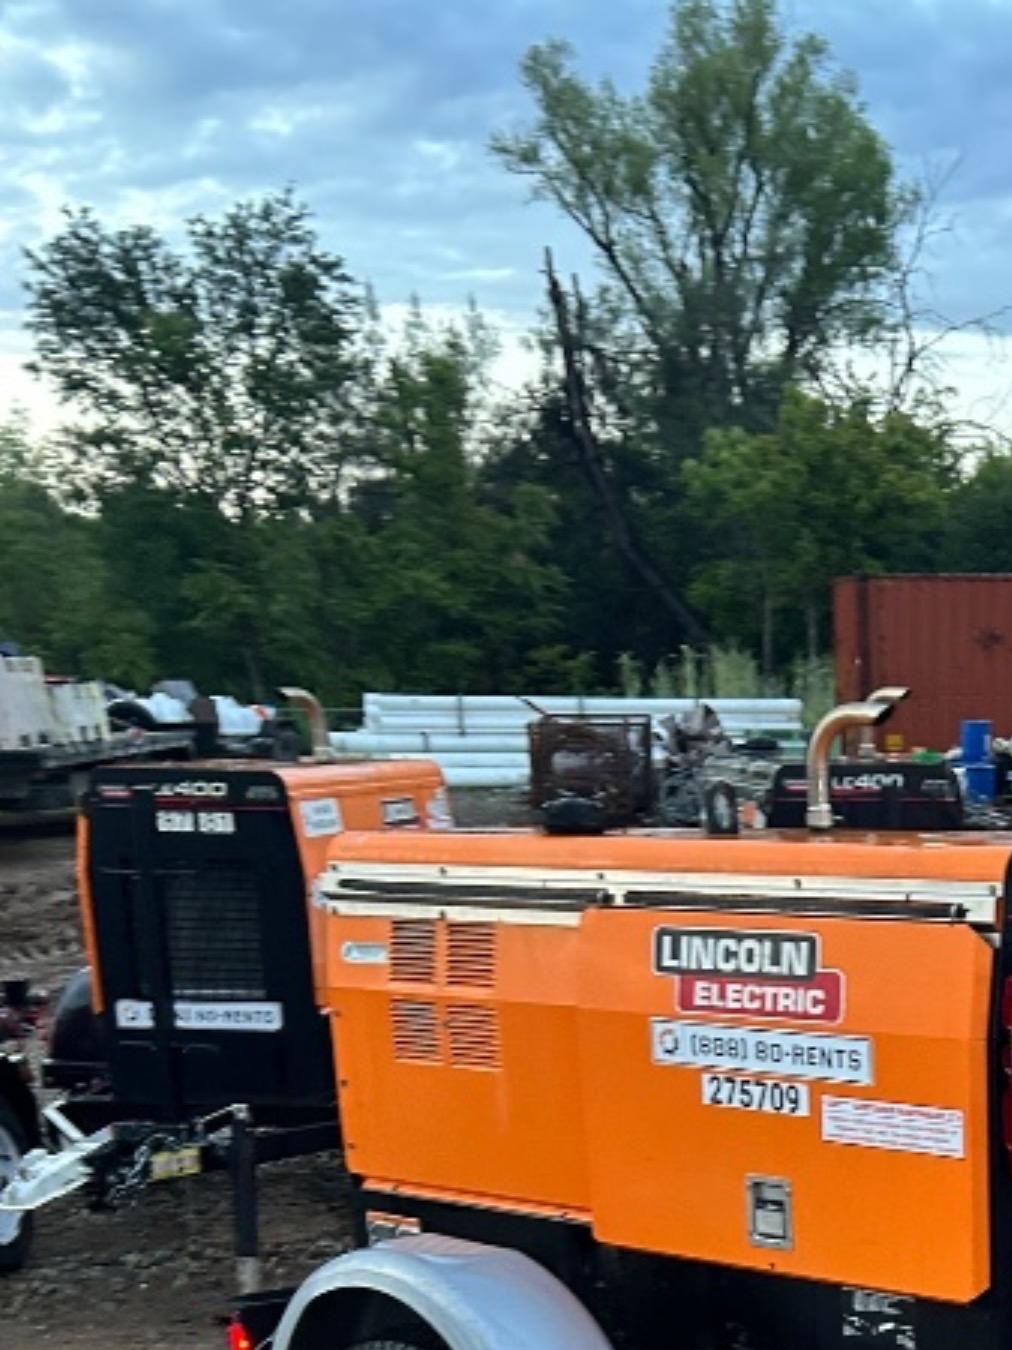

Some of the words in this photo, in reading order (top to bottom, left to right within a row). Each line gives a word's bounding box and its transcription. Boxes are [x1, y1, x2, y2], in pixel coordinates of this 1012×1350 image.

[660, 934, 811, 977] LINCOLN
[692, 980, 827, 1016] ELECTRIC
[755, 1041, 862, 1071] 80-RENTS
[707, 1075, 801, 1114] 275709
